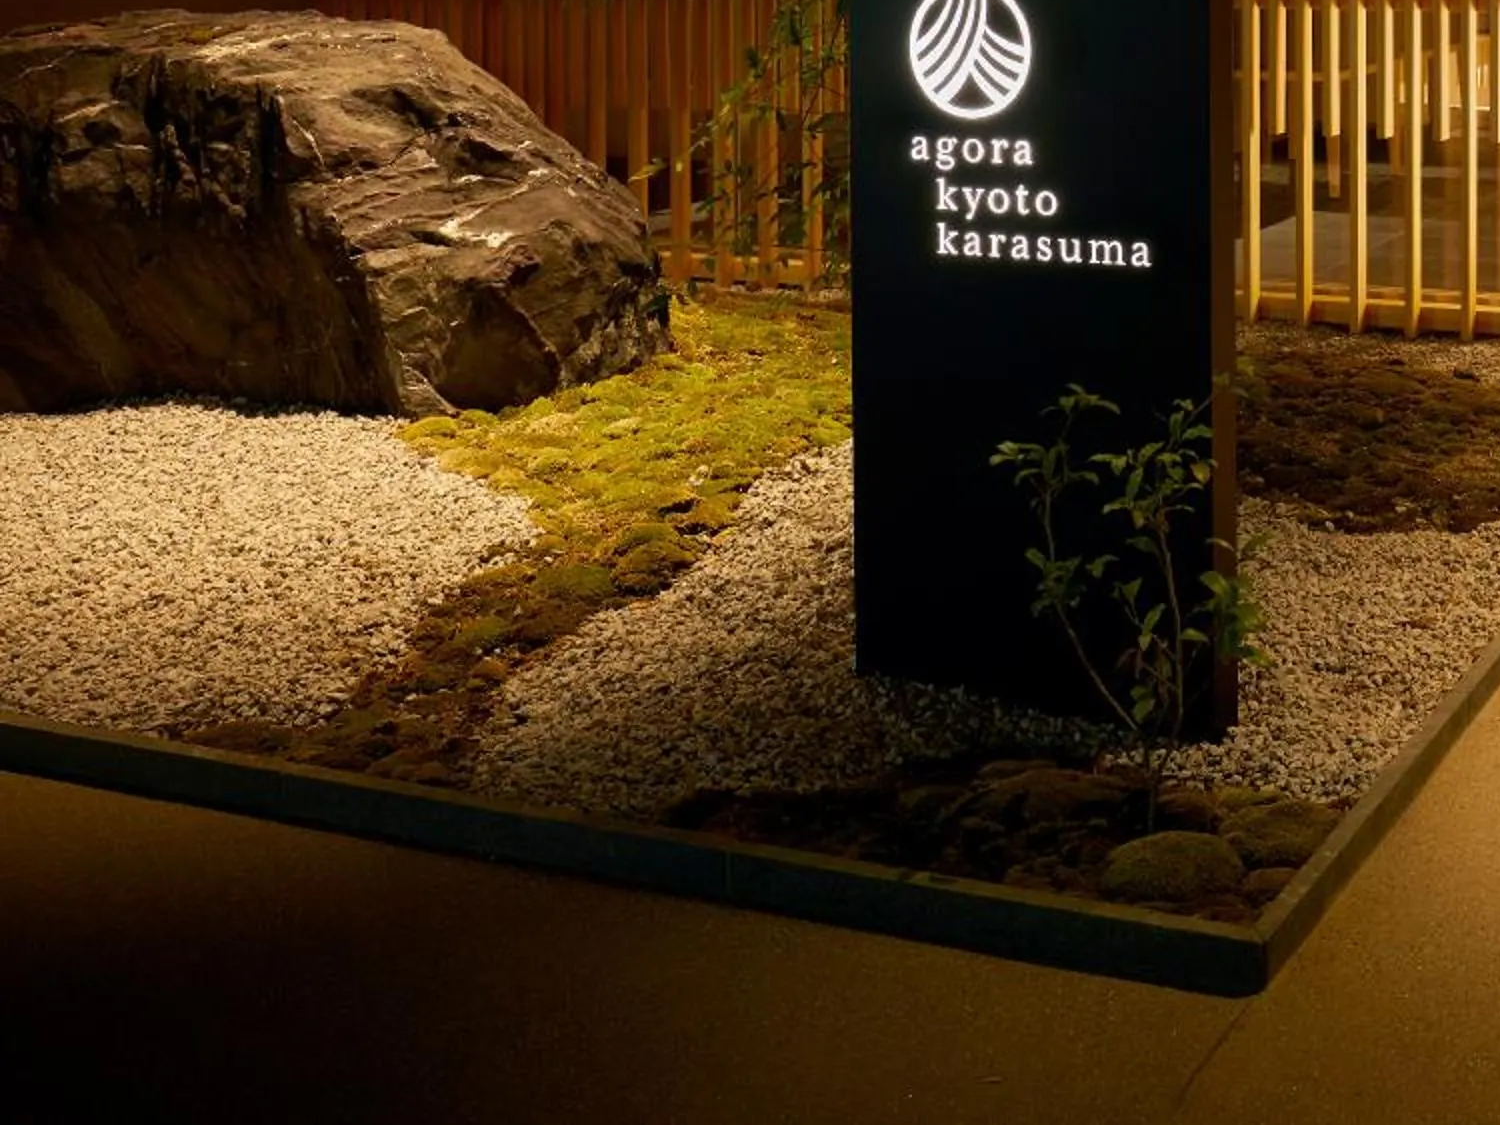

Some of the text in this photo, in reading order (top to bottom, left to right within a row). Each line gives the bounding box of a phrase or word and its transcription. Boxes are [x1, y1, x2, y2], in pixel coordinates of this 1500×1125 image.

[910, 135, 1035, 172] agora
[935, 176, 1060, 221] kyoto
[936, 221, 1153, 268] karasuma
